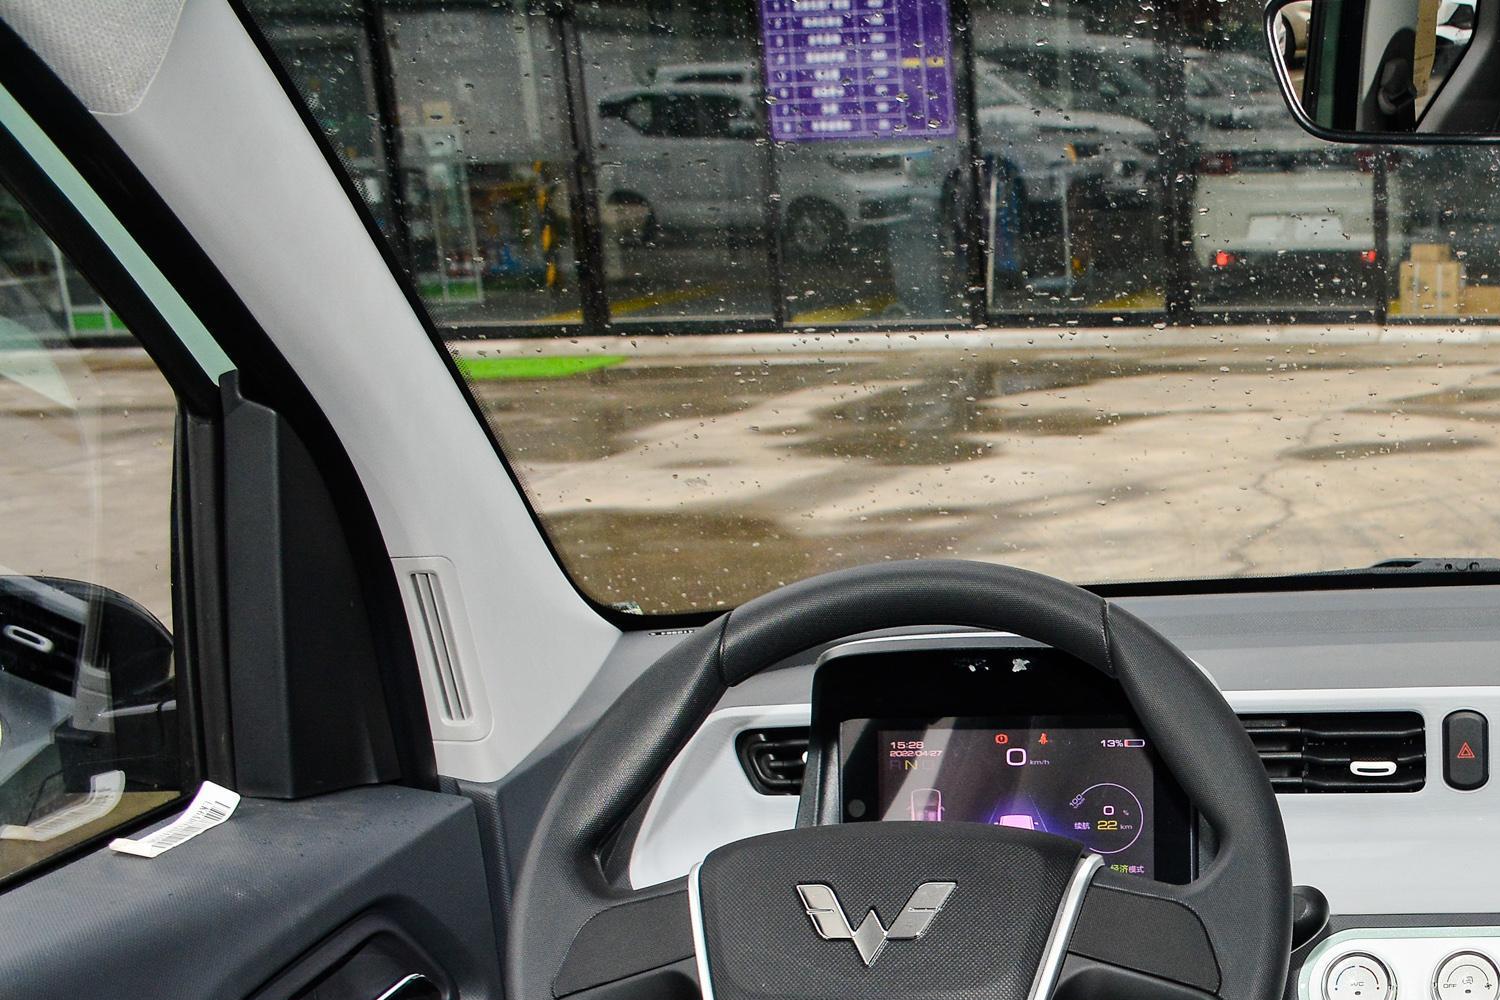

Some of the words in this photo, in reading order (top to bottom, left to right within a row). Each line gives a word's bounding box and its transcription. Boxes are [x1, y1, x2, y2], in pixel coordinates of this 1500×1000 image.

[890, 741, 924, 749] 15:28
[1100, 739, 1123, 747] 13%
[1006, 748, 1027, 766] 0
[904, 759, 918, 770] N
[1097, 820, 1118, 830] 22
